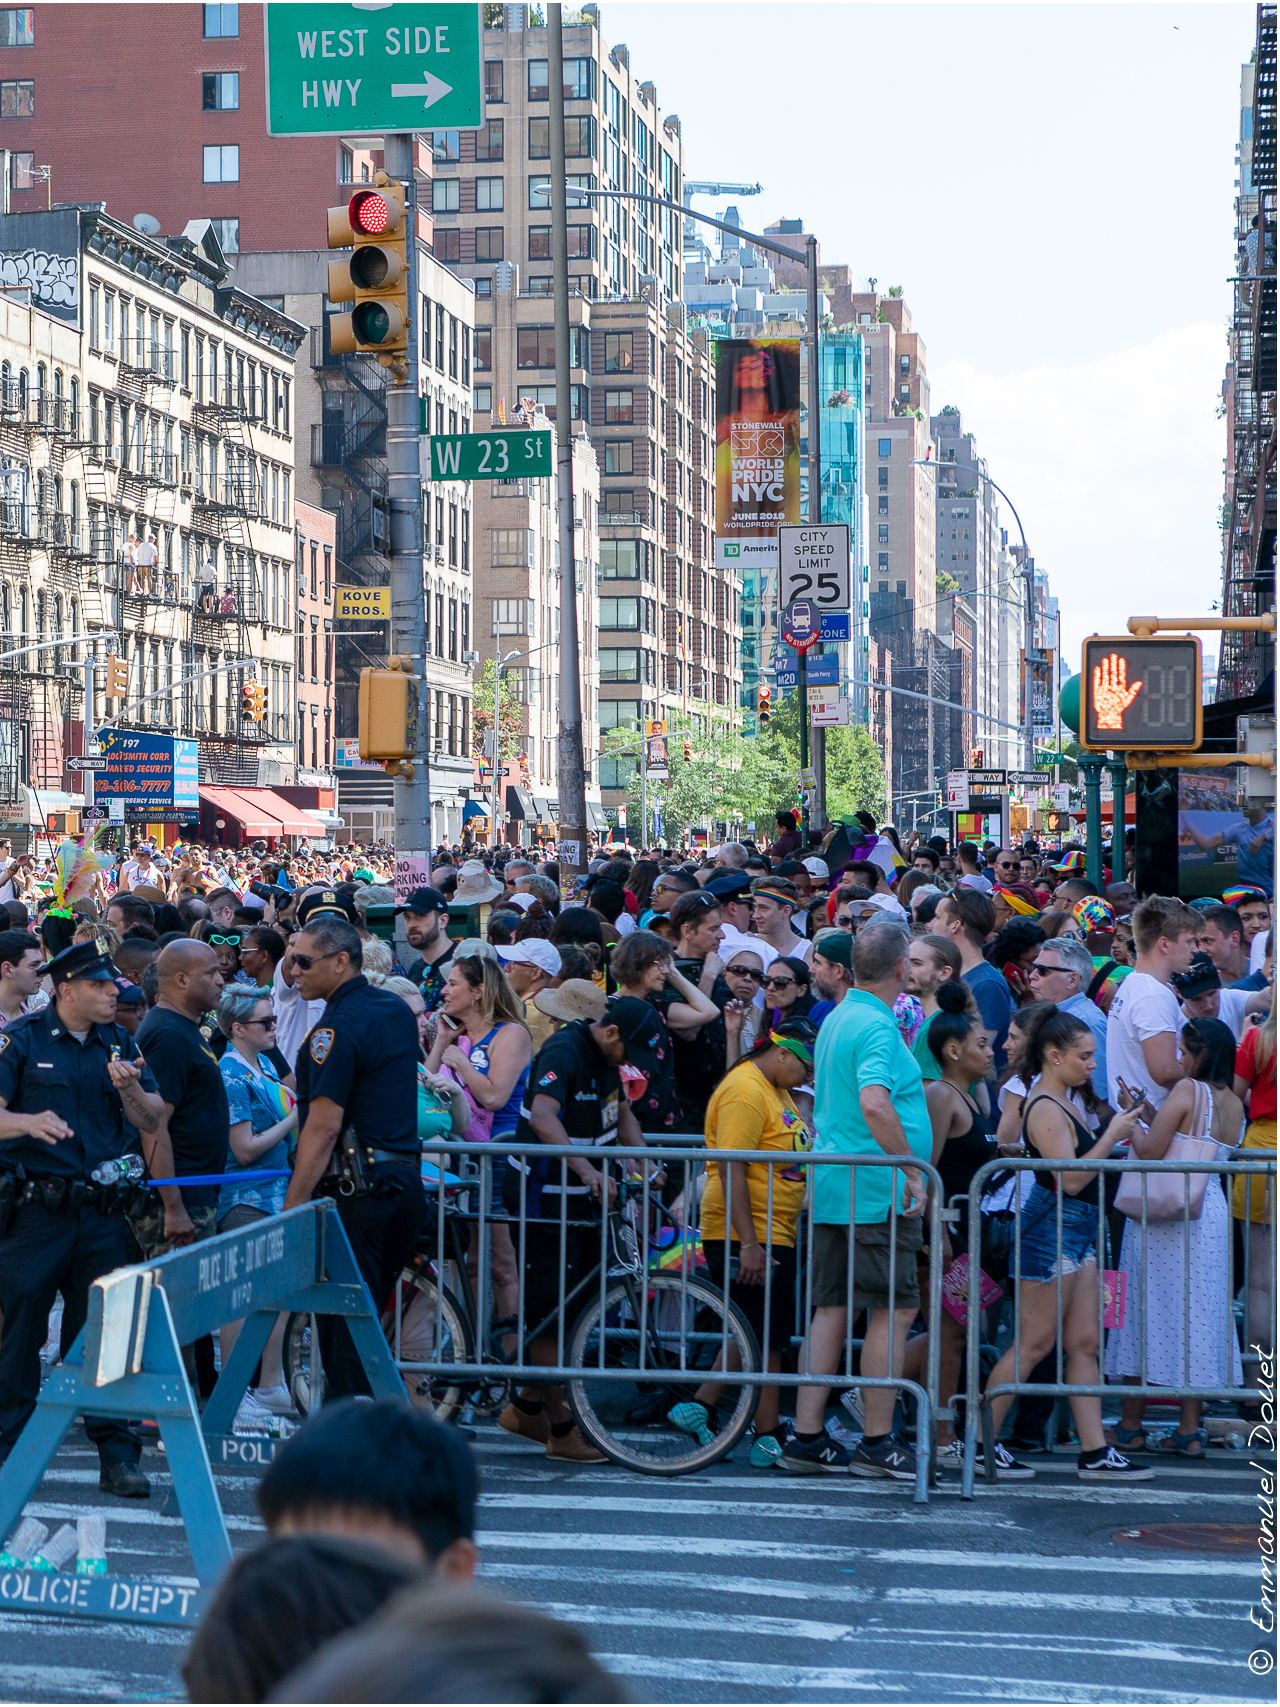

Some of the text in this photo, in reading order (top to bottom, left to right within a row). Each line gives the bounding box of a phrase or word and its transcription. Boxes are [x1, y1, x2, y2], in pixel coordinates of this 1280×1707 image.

[297, 26, 450, 58] WEST SIDE
[302, 79, 362, 108] HWY
[731, 422, 784, 430] STONEWALL
[435, 438, 543, 475] W 23 St
[731, 459, 784, 470] WORLD
[731, 470, 784, 483] PRIDE
[731, 483, 784, 503] NYC
[731, 512, 785, 521] JUNE 2019
[800, 531, 828, 542] CITY
[725, 545, 779, 555] TD Ameritr
[794, 545, 834, 555] SPEED
[799, 558, 831, 569] LIMIT
[789, 573, 841, 604] 25
[343, 592, 381, 601] KOVE
[342, 606, 385, 615] BROS.
[785, 632, 818, 646] NO STANDING
[819, 629, 846, 638] ZONE
[775, 659, 788, 670] M7
[777, 673, 795, 684] M20
[122, 739, 140, 748] 197
[149, 752, 170, 762] CORP.
[1036, 754, 1043, 763] W
[1046, 754, 1055, 763] 22
[136, 765, 172, 774] SECURITY
[124, 797, 151, 805] ERGENCY
[35, 832, 57, 840] ATM
[396, 861, 410, 872] NO
[394, 872, 427, 886] RKING
[198, 1226, 284, 1294] POLICE LINE DO NOT CROSS
[231, 1281, 252, 1310] NYPD
[222, 1440, 276, 1464] POLI
